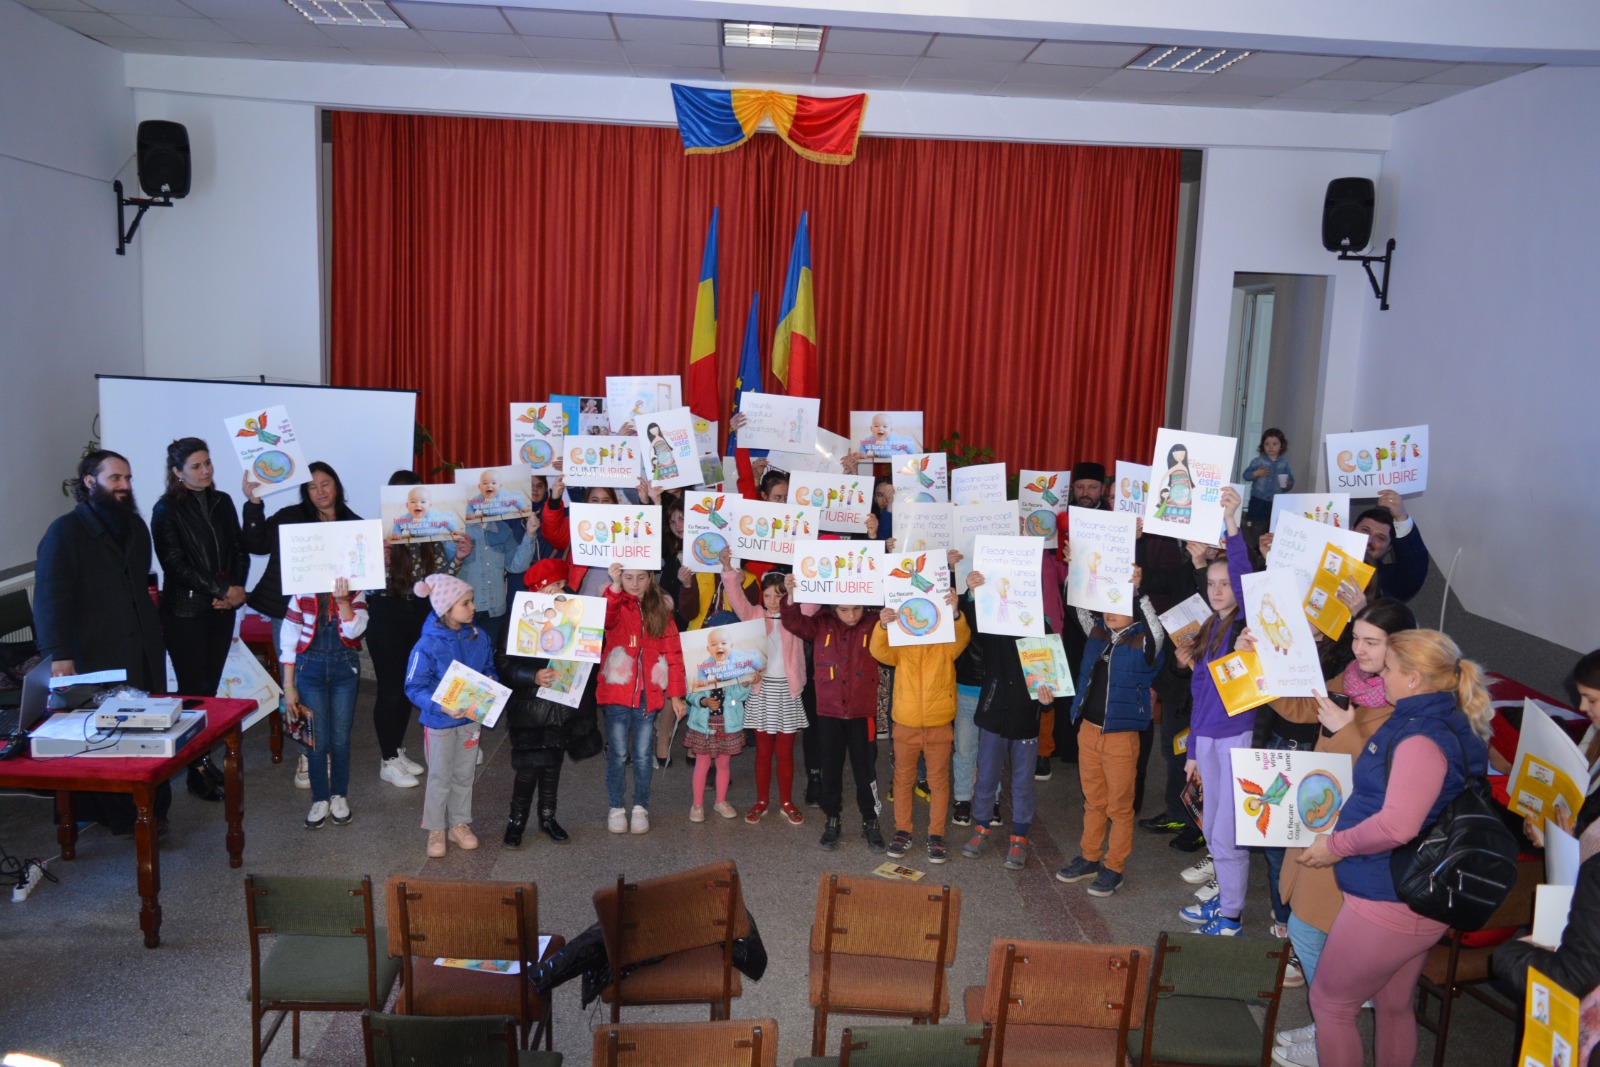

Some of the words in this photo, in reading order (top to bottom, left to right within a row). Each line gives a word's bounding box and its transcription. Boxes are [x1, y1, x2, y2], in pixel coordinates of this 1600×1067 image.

[569, 466, 599, 477] SUNT
[600, 467, 632, 478] IUBIRE
[983, 473, 1000, 483] copil
[1198, 478, 1221, 487] este
[1338, 474, 1376, 488] SUNT
[1378, 469, 1418, 486] IUBIRE
[956, 485, 978, 493] poate
[1205, 487, 1218, 495] un
[1200, 493, 1218, 502] dar
[1120, 499, 1141, 513] SUNT
[825, 510, 861, 523] IUBIRE
[931, 513, 948, 523] copil
[993, 512, 1012, 521] copil
[963, 524, 988, 533] poate
[1074, 518, 1106, 530] Fiecare
[1108, 525, 1128, 535] copil
[1076, 530, 1101, 540] poate
[1104, 533, 1126, 544] face
[737, 536, 770, 550] SUNT
[770, 542, 795, 554] IUBI
[578, 543, 610, 557] SUNT
[612, 545, 651, 558] IUBIRE
[980, 545, 1014, 555] Fiecare
[1015, 548, 1036, 559] copil
[1011, 557, 1032, 566] face
[800, 580, 834, 593] SUNT
[835, 581, 874, 594] IUBIRE
[1255, 752, 1260, 761] un
[1287, 830, 1294, 840] Cu
